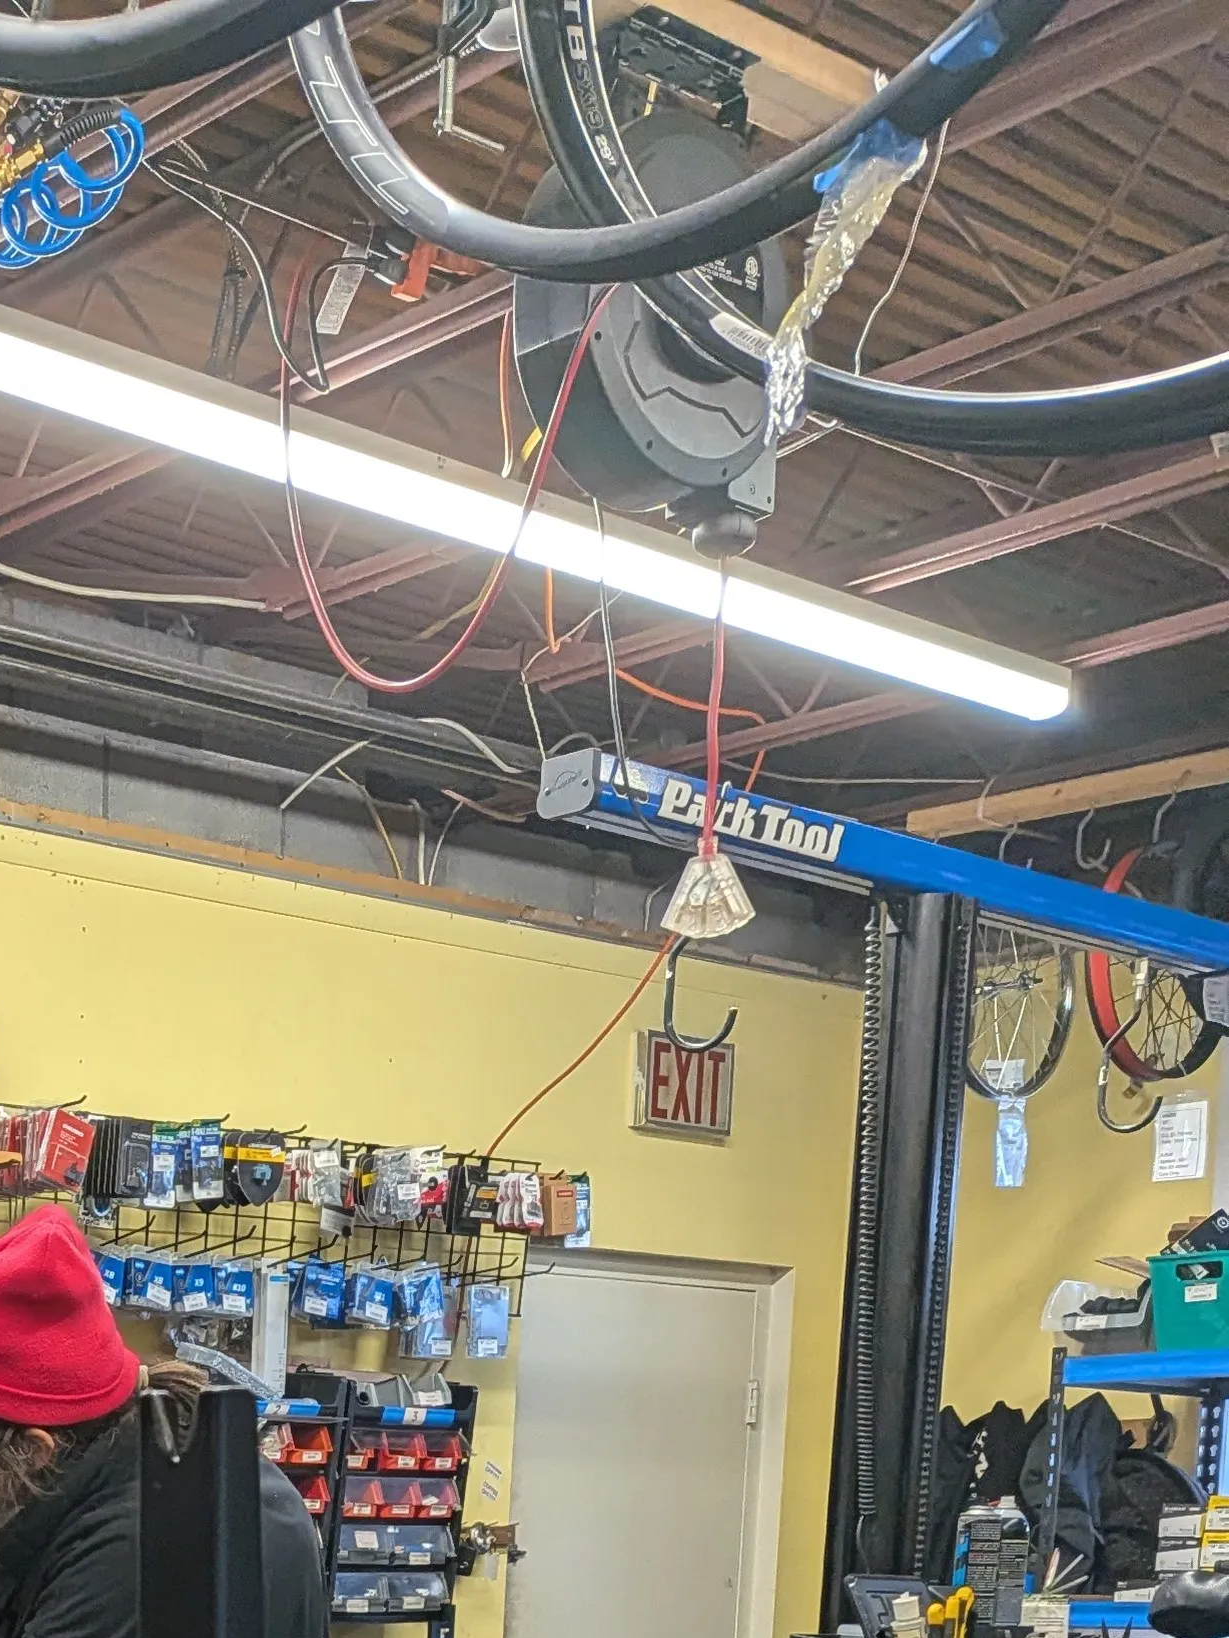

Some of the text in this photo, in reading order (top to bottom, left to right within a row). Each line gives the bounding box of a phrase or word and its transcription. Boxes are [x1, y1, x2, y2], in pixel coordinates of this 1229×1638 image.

[657, 778, 845, 862] Park Tool
[651, 1041, 725, 1126] EXIT
[194, 1278, 204, 1287] X9
[411, 1410, 419, 1422] 3
